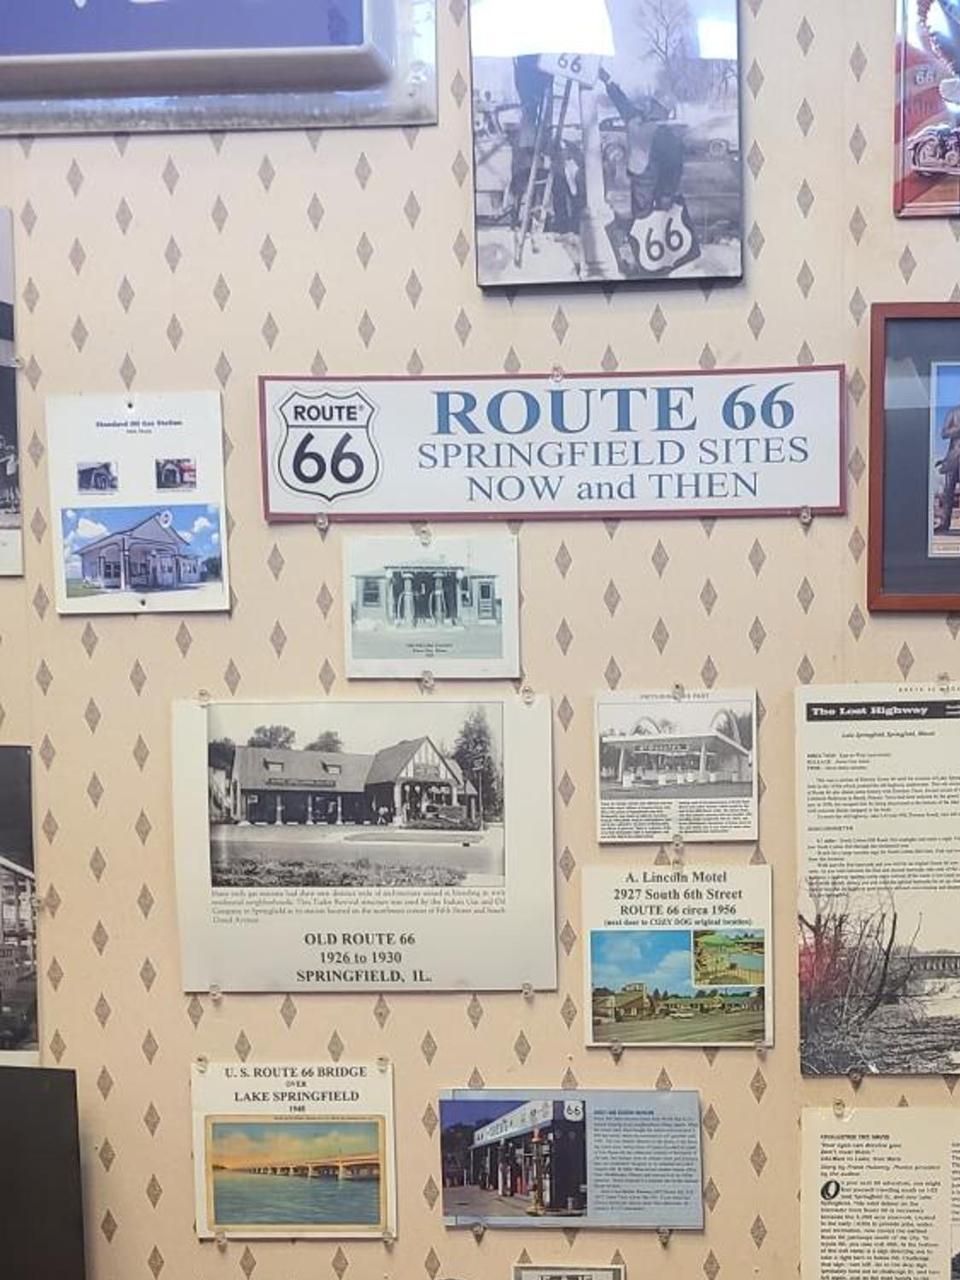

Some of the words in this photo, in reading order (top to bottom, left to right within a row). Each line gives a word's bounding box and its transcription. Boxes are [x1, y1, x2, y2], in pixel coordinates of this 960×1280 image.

[557, 52, 582, 73] 66
[645, 217, 684, 261] 66
[294, 404, 357, 421] ROUTE
[432, 385, 697, 436] ROUTE
[721, 382, 796, 431] 66
[293, 432, 364, 484] 66
[418, 438, 685, 469] SPRINGFIELD
[699, 436, 809, 465] SITES
[466, 474, 564, 502] NOW
[577, 474, 636, 501] and
[648, 471, 759, 498] THEN
[871, 704, 929, 717] Highway
[625, 872, 639, 883] A.
[643, 871, 689, 883] Lincoln
[692, 871, 727, 883] Motel
[614, 888, 642, 900] 2927
[645, 888, 680, 900] South
[683, 888, 702, 900] 6th
[706, 888, 743, 900] Street
[620, 905, 662, 916] ROUTE
[666, 904, 680, 916] 66
[682, 905, 708, 916] circa
[711, 904, 737, 915] 1956
[304, 932, 339, 946] OLD
[342, 932, 395, 946] ROUTE
[399, 932, 416, 946] 66
[319, 951, 351, 965] 1926
[353, 951, 368, 965] to
[371, 951, 403, 965] 1930
[296, 968, 406, 985] SPRINGFIELD,
[253, 1067, 298, 1078] ROUTE
[301, 1067, 315, 1078] 66
[317, 1066, 368, 1077] BRIDGE
[234, 1091, 270, 1102] LAKE
[272, 1091, 360, 1102] SPRINGFIELD
